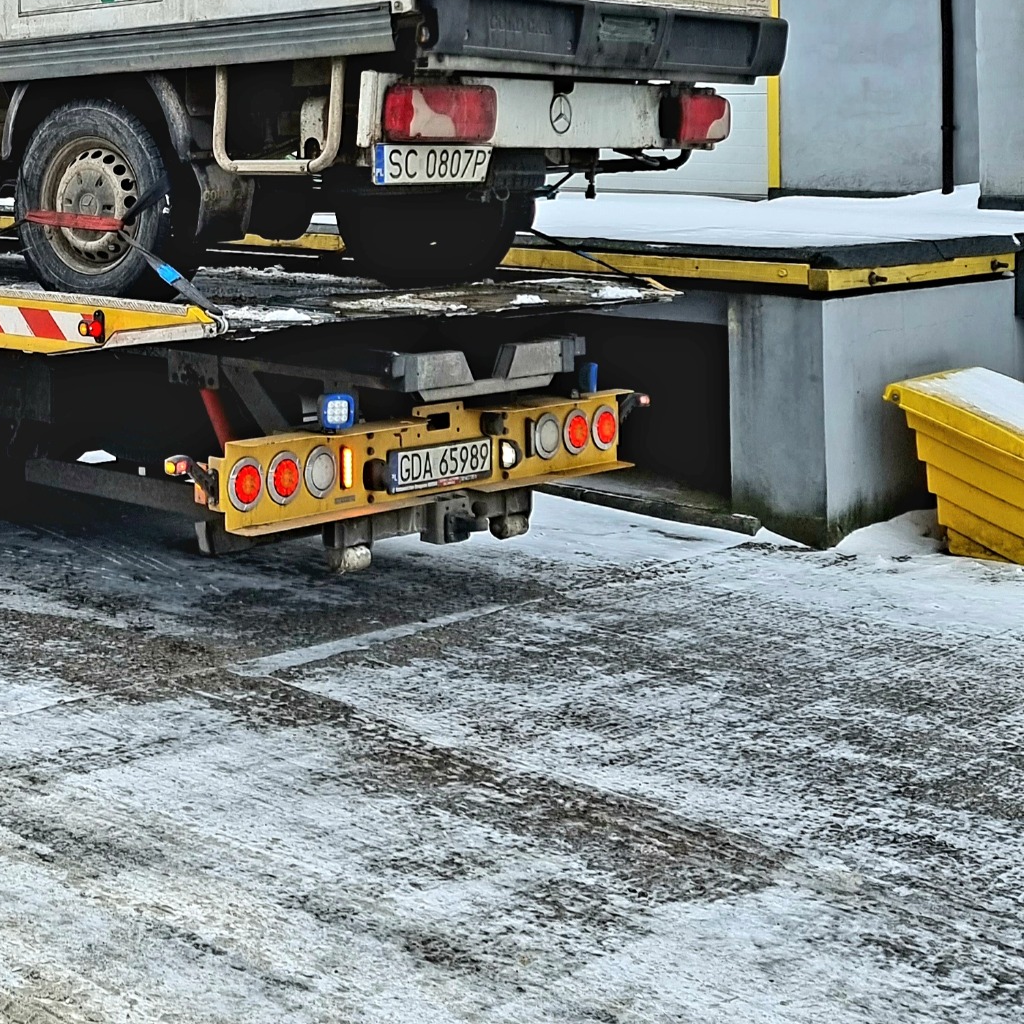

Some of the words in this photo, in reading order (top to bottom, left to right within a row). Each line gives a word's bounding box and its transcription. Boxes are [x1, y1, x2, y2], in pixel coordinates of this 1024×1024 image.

[389, 148, 419, 179] SC
[425, 148, 487, 179] 0807P
[400, 451, 433, 482] GDA
[439, 442, 489, 477] 65989
